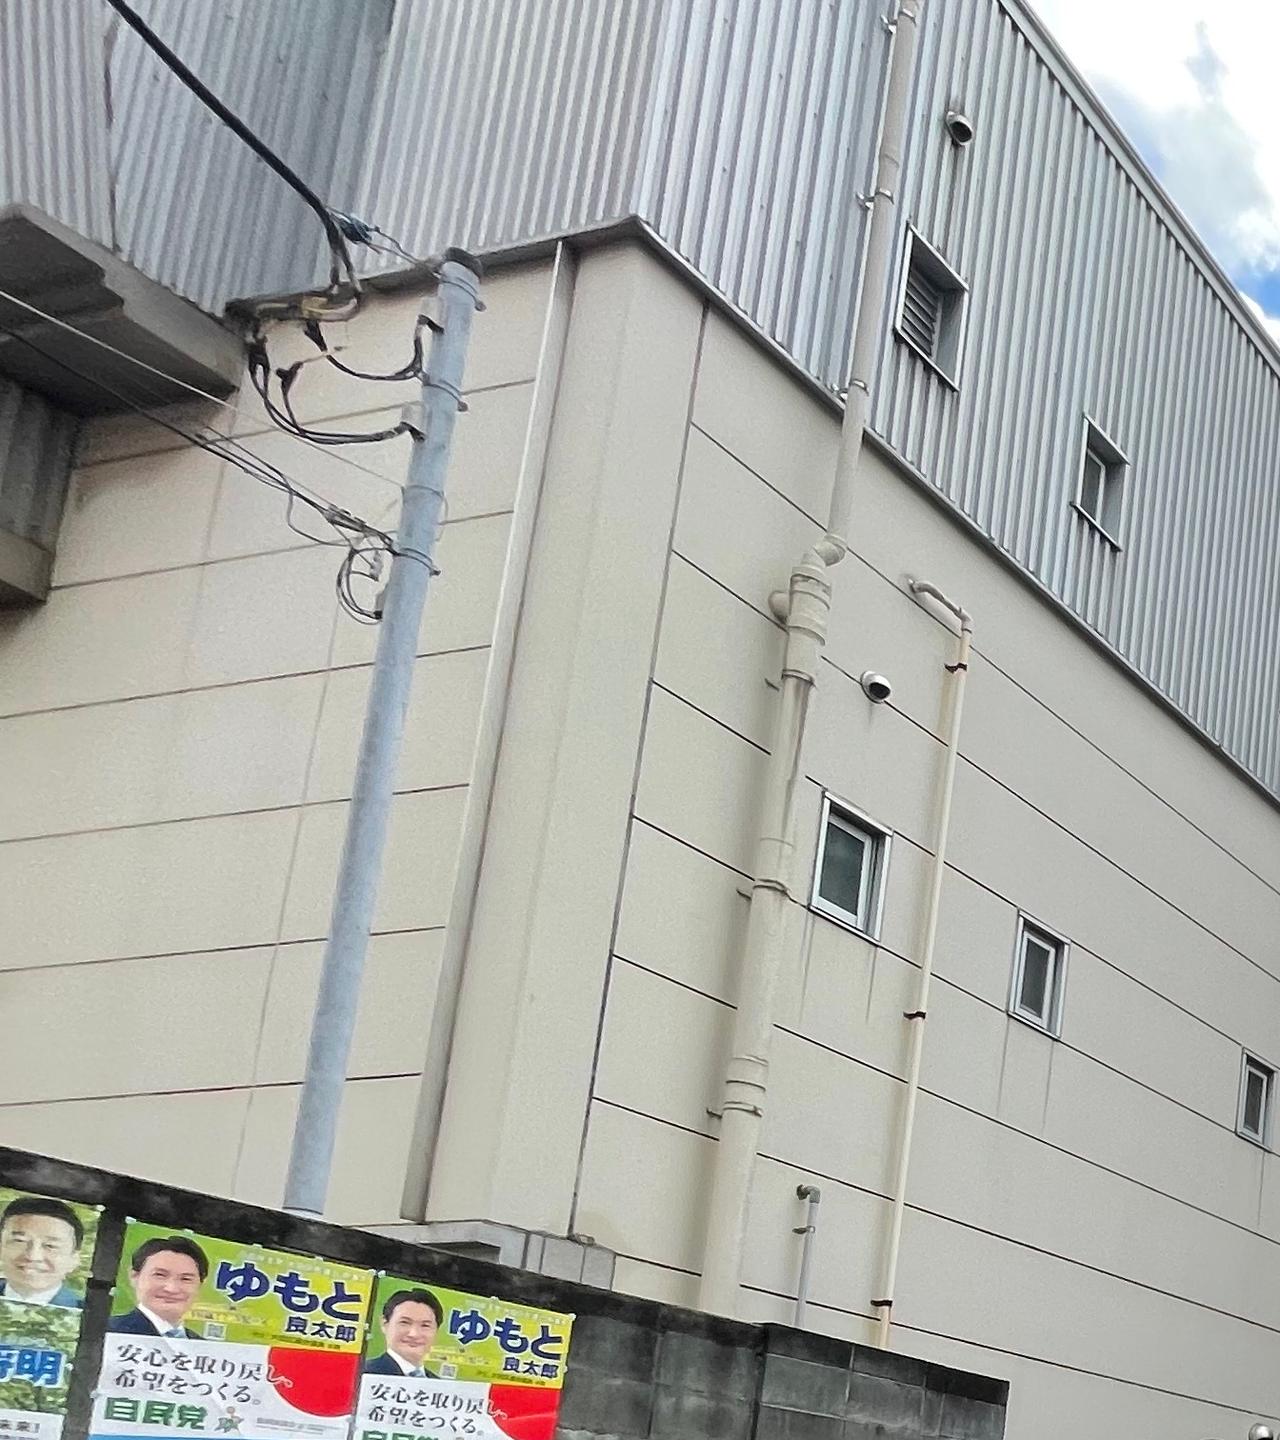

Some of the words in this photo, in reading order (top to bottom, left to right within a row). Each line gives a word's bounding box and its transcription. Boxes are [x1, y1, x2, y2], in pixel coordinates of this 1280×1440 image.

[216, 1260, 362, 1322] ゆもと
[285, 1315, 357, 1343] 良太郎
[449, 1309, 563, 1361] ゆもと
[504, 1356, 559, 1380] 良太郎
[104, 1396, 208, 1431] 自民党
